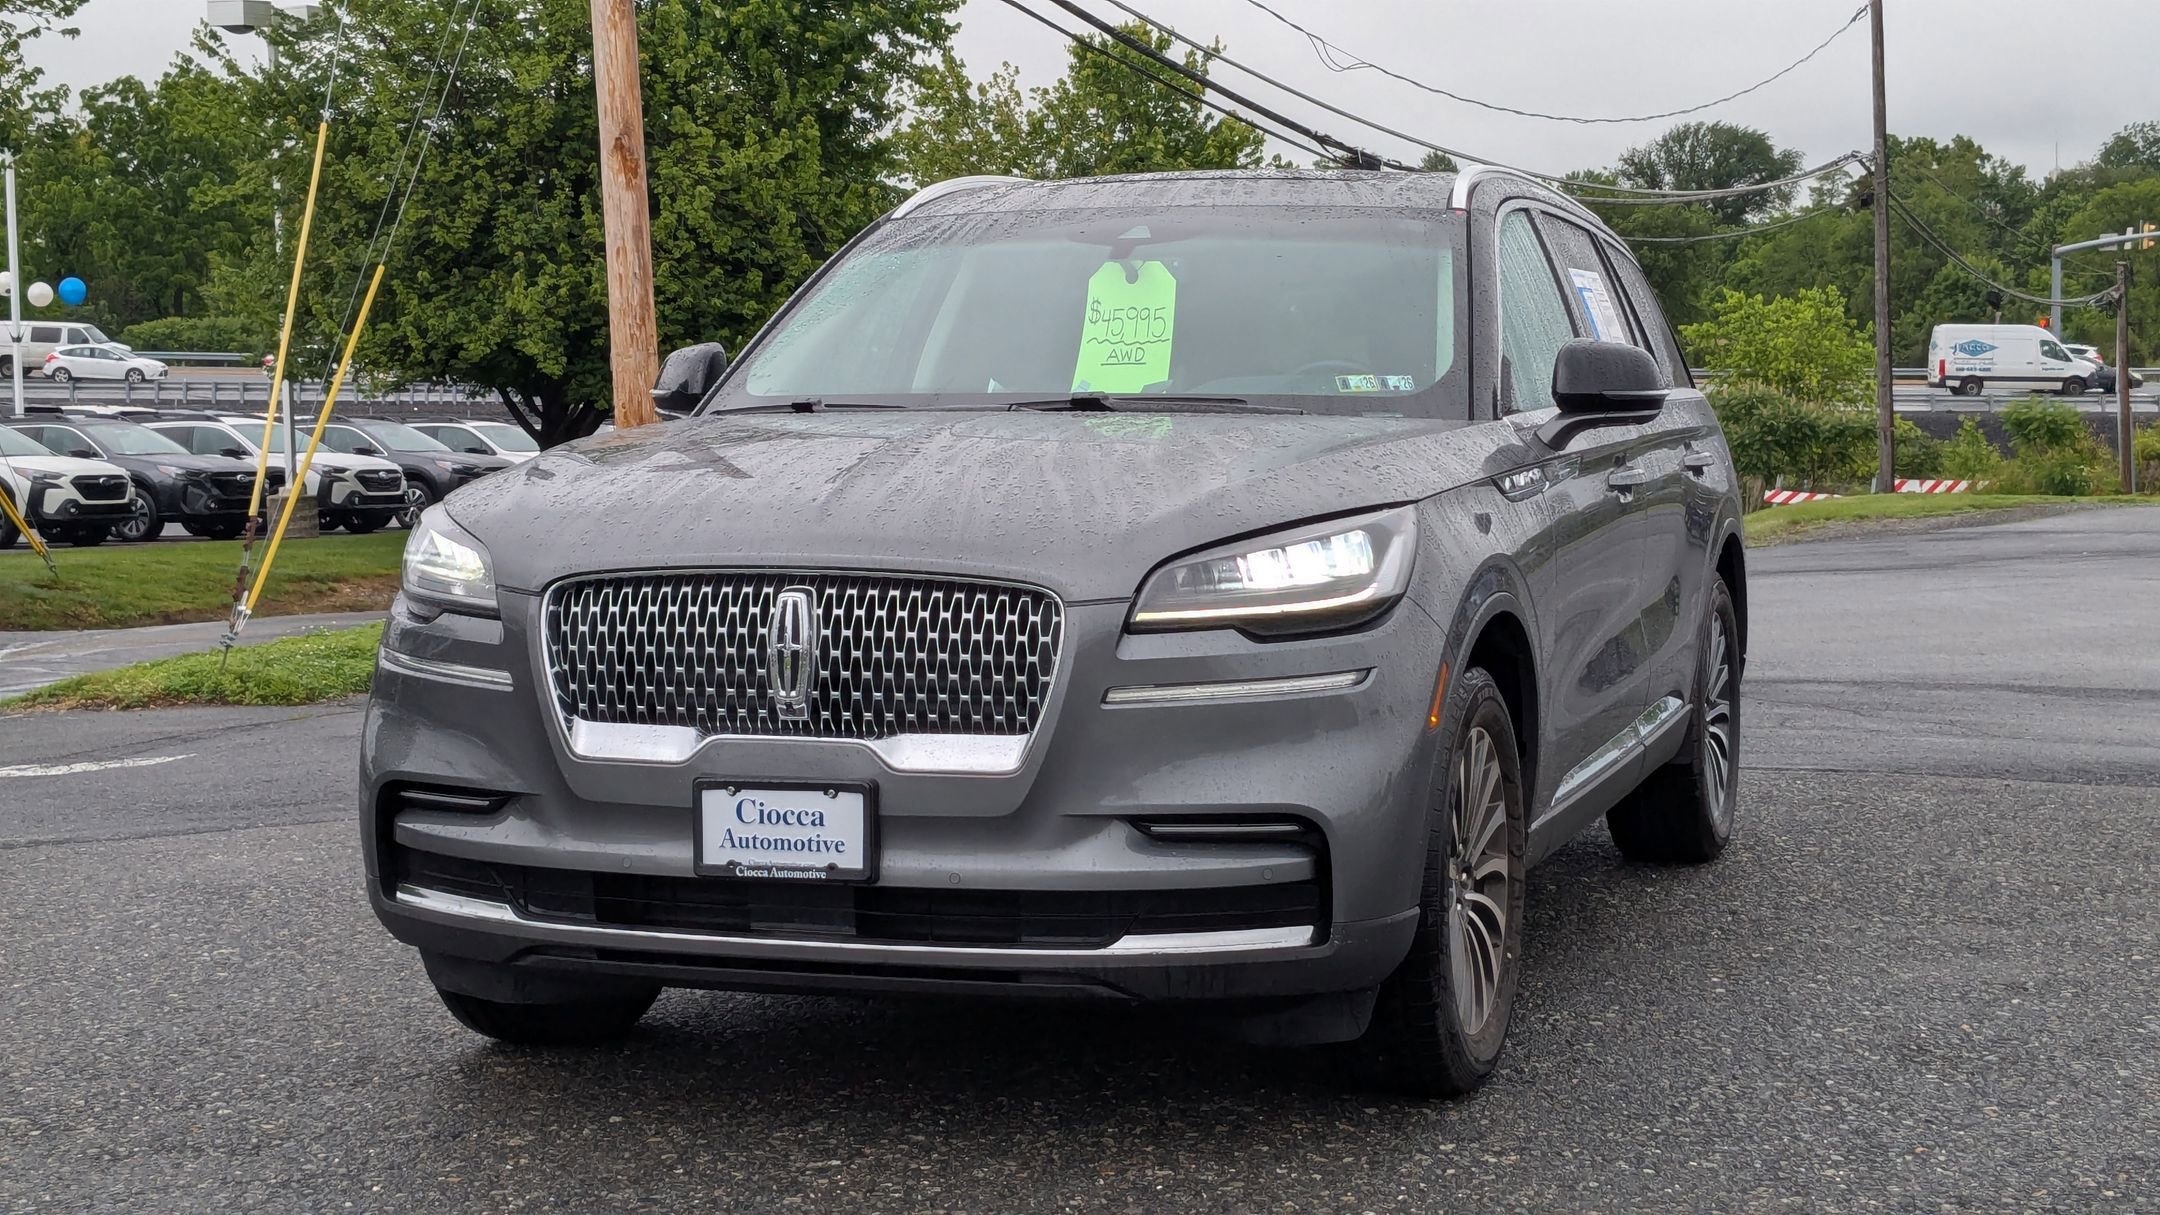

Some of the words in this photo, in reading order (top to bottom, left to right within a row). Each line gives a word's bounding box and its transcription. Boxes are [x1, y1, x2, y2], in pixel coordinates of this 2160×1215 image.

[1106, 347, 1145, 362] AWD
[735, 799, 825, 827] Ciocca
[719, 828, 845, 853] Automotive
[735, 865, 768, 877] Ciocca
[770, 867, 827, 878] Automotive
